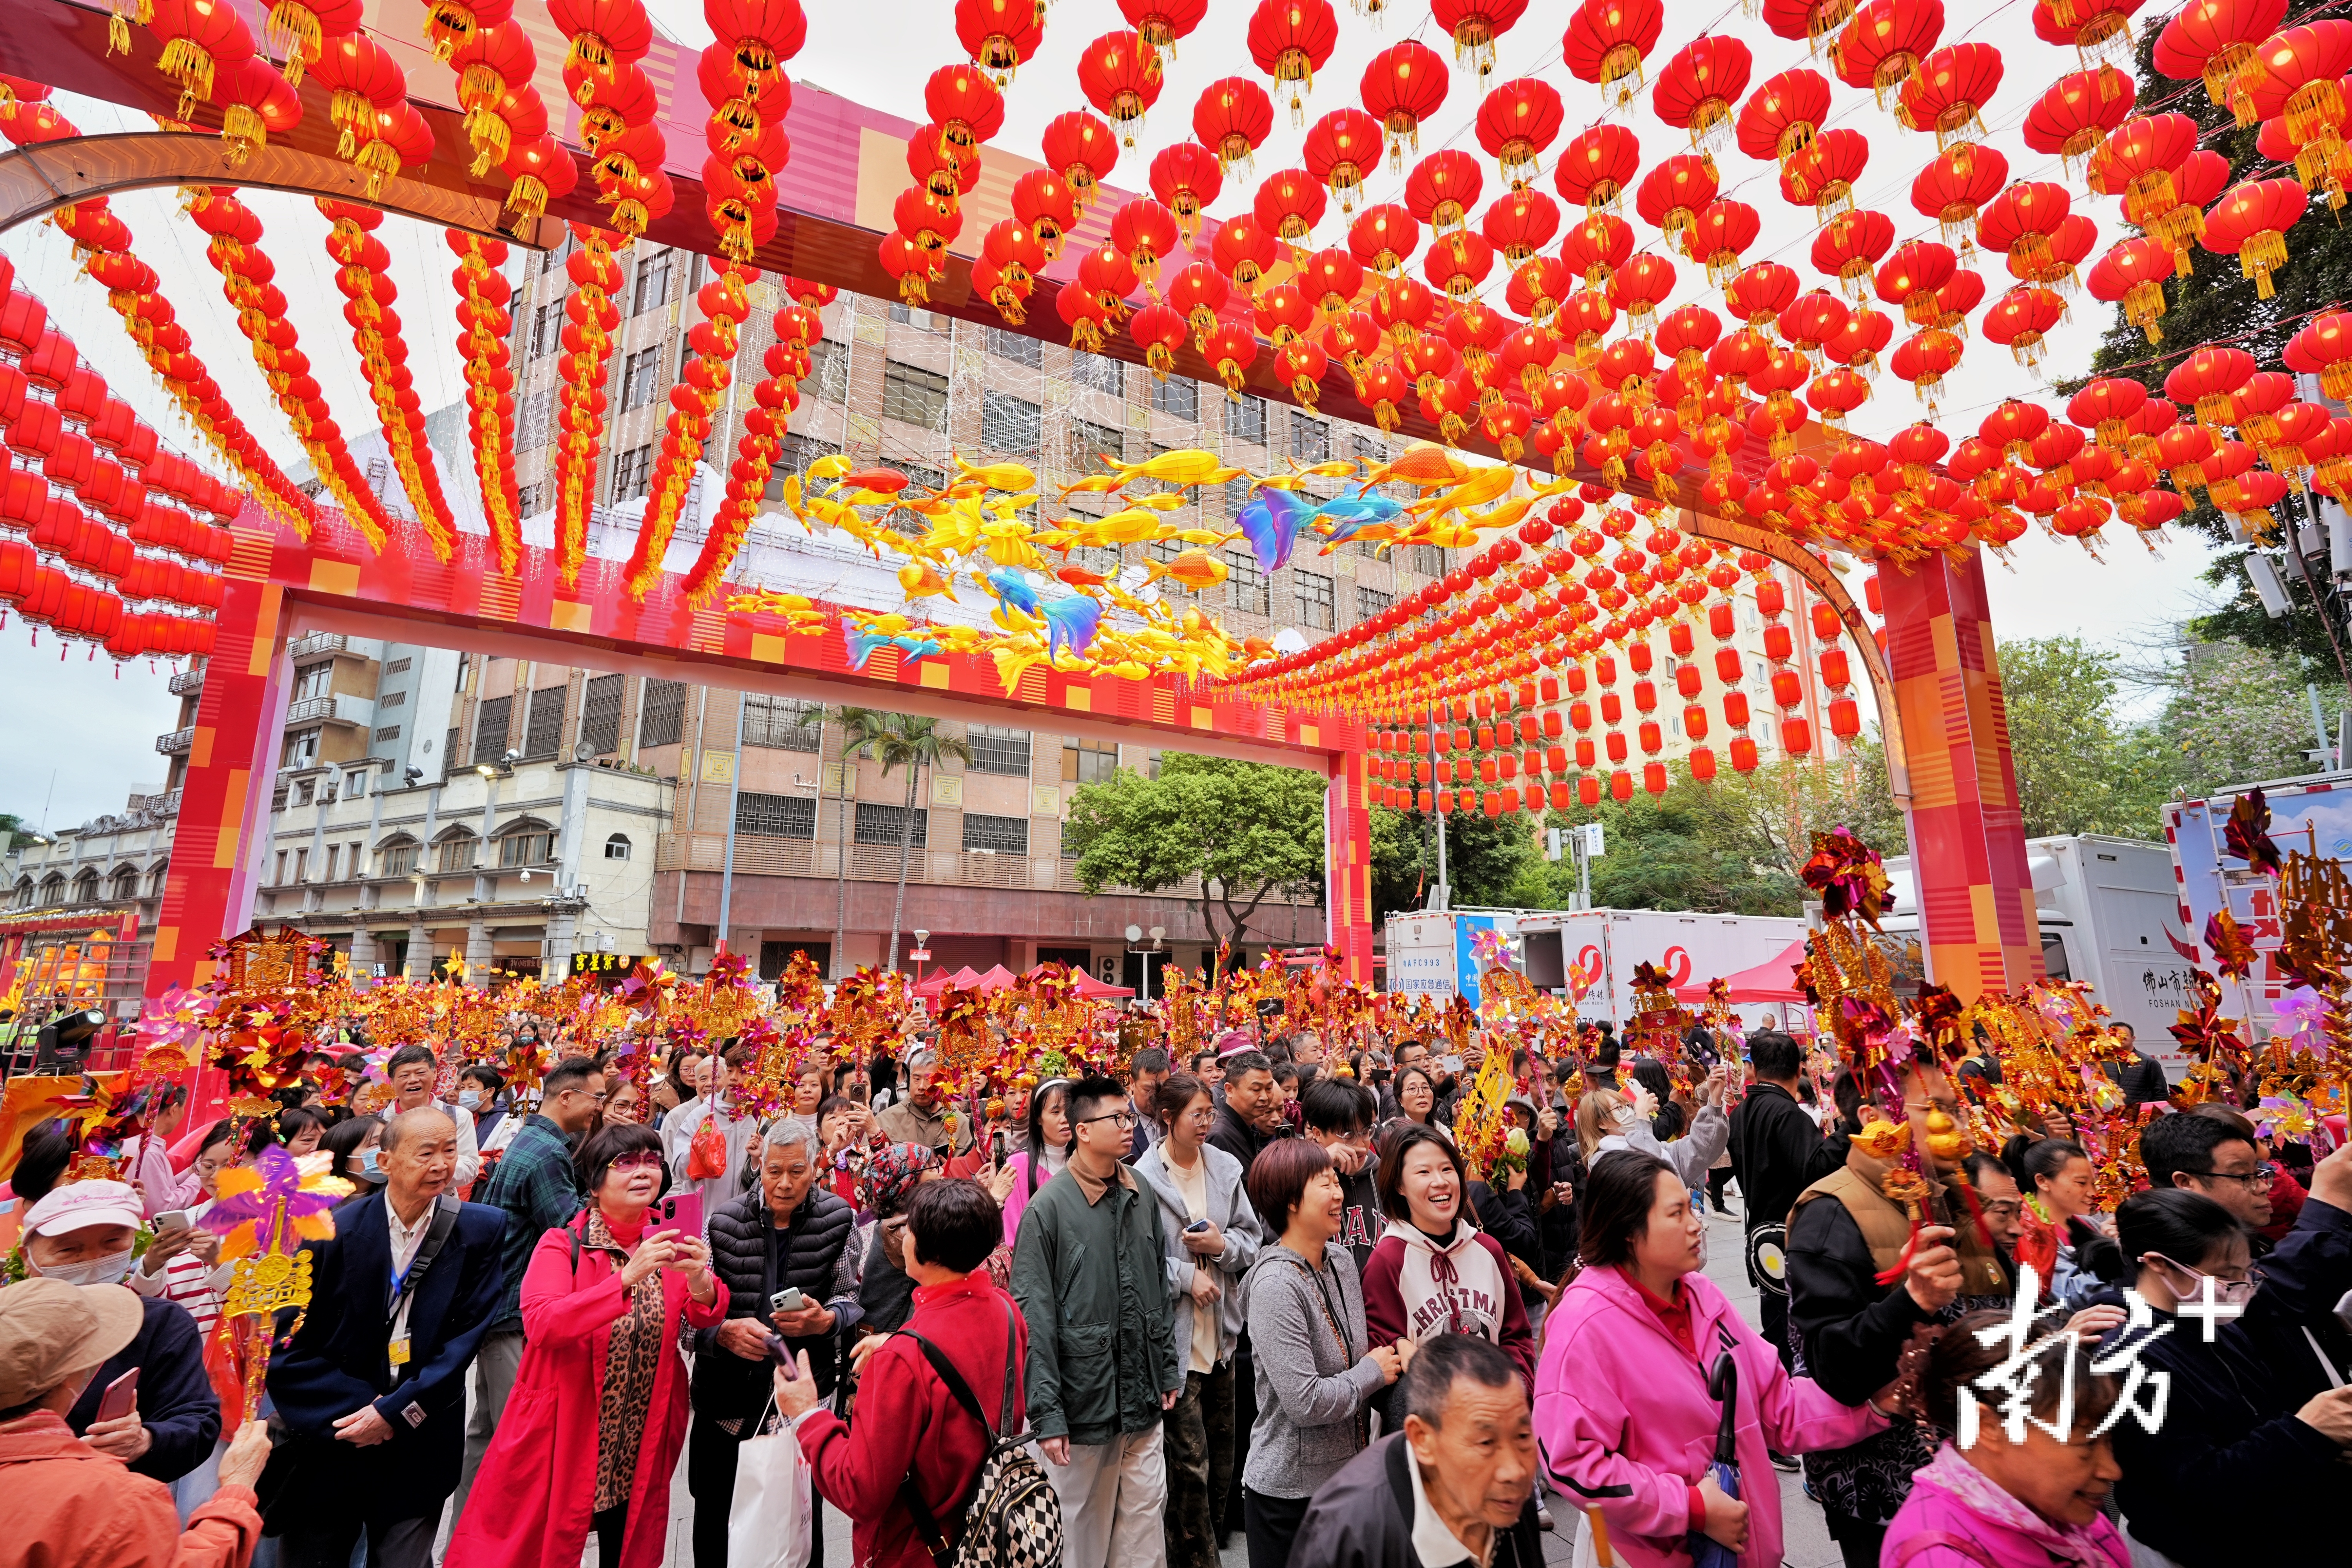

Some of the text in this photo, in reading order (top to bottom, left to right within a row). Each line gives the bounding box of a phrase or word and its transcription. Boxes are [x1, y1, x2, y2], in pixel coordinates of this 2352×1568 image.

[1406, 979, 1450, 989] 国家应急通信
[2149, 1000, 2180, 1008] FOSHAN
[1429, 1323, 1437, 1332] ONLY
